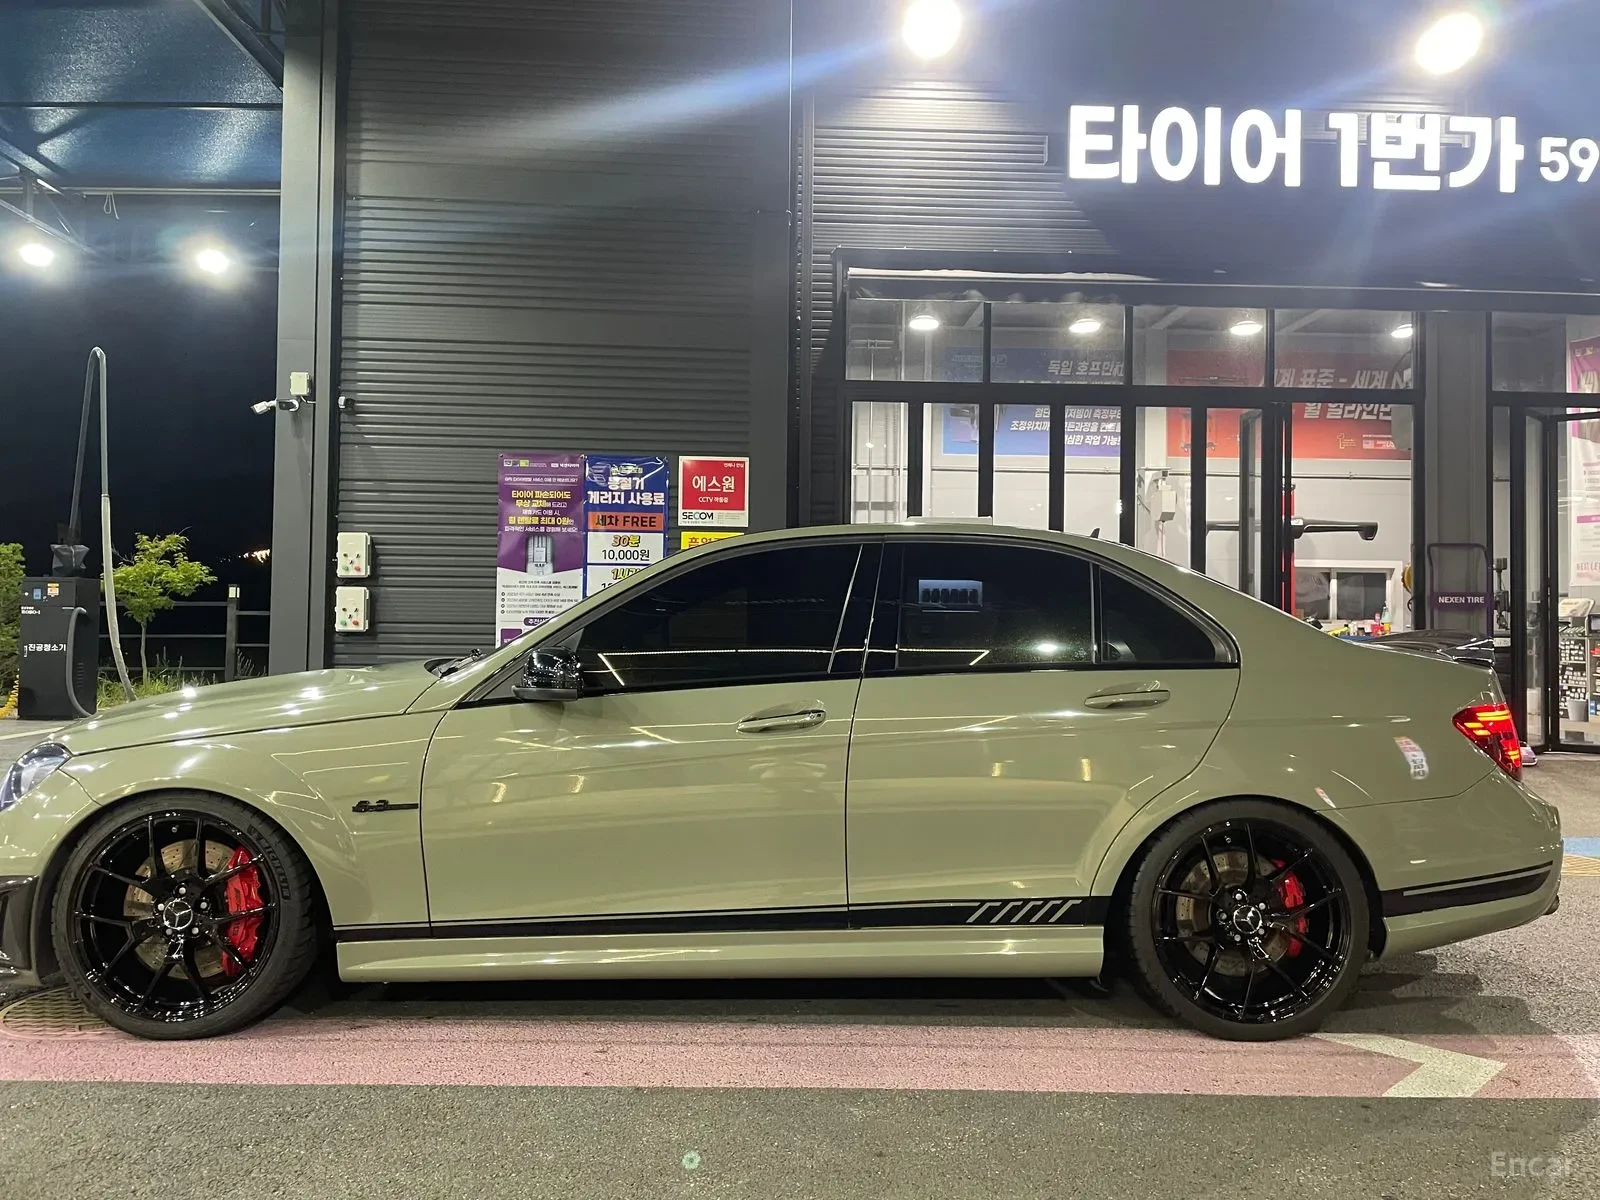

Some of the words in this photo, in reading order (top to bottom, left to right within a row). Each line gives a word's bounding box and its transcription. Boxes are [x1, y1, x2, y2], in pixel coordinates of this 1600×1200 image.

[1069, 104, 1302, 187] 타이어
[1328, 112, 1525, 193] 1번가
[1048, 360, 1073, 375] 독일
[1301, 368, 1335, 388] 표준
[1351, 370, 1388, 389] 세계
[692, 475, 735, 492] 에스원
[512, 490, 533, 499] 타이어
[534, 490, 571, 499] 파손되어도
[587, 491, 624, 504] 게러지
[628, 491, 665, 505] 사용료
[540, 516, 556, 524] 최대
[596, 515, 619, 526] 세차
[623, 516, 656, 527] FREE
[682, 511, 714, 520] SECOM
[612, 535, 641, 548] 30분
[602, 549, 650, 561] 10,000원
[1438, 596, 1465, 604] NEXEN
[1466, 596, 1485, 604] TIRE
[28, 643, 66, 652] 진공청소기
